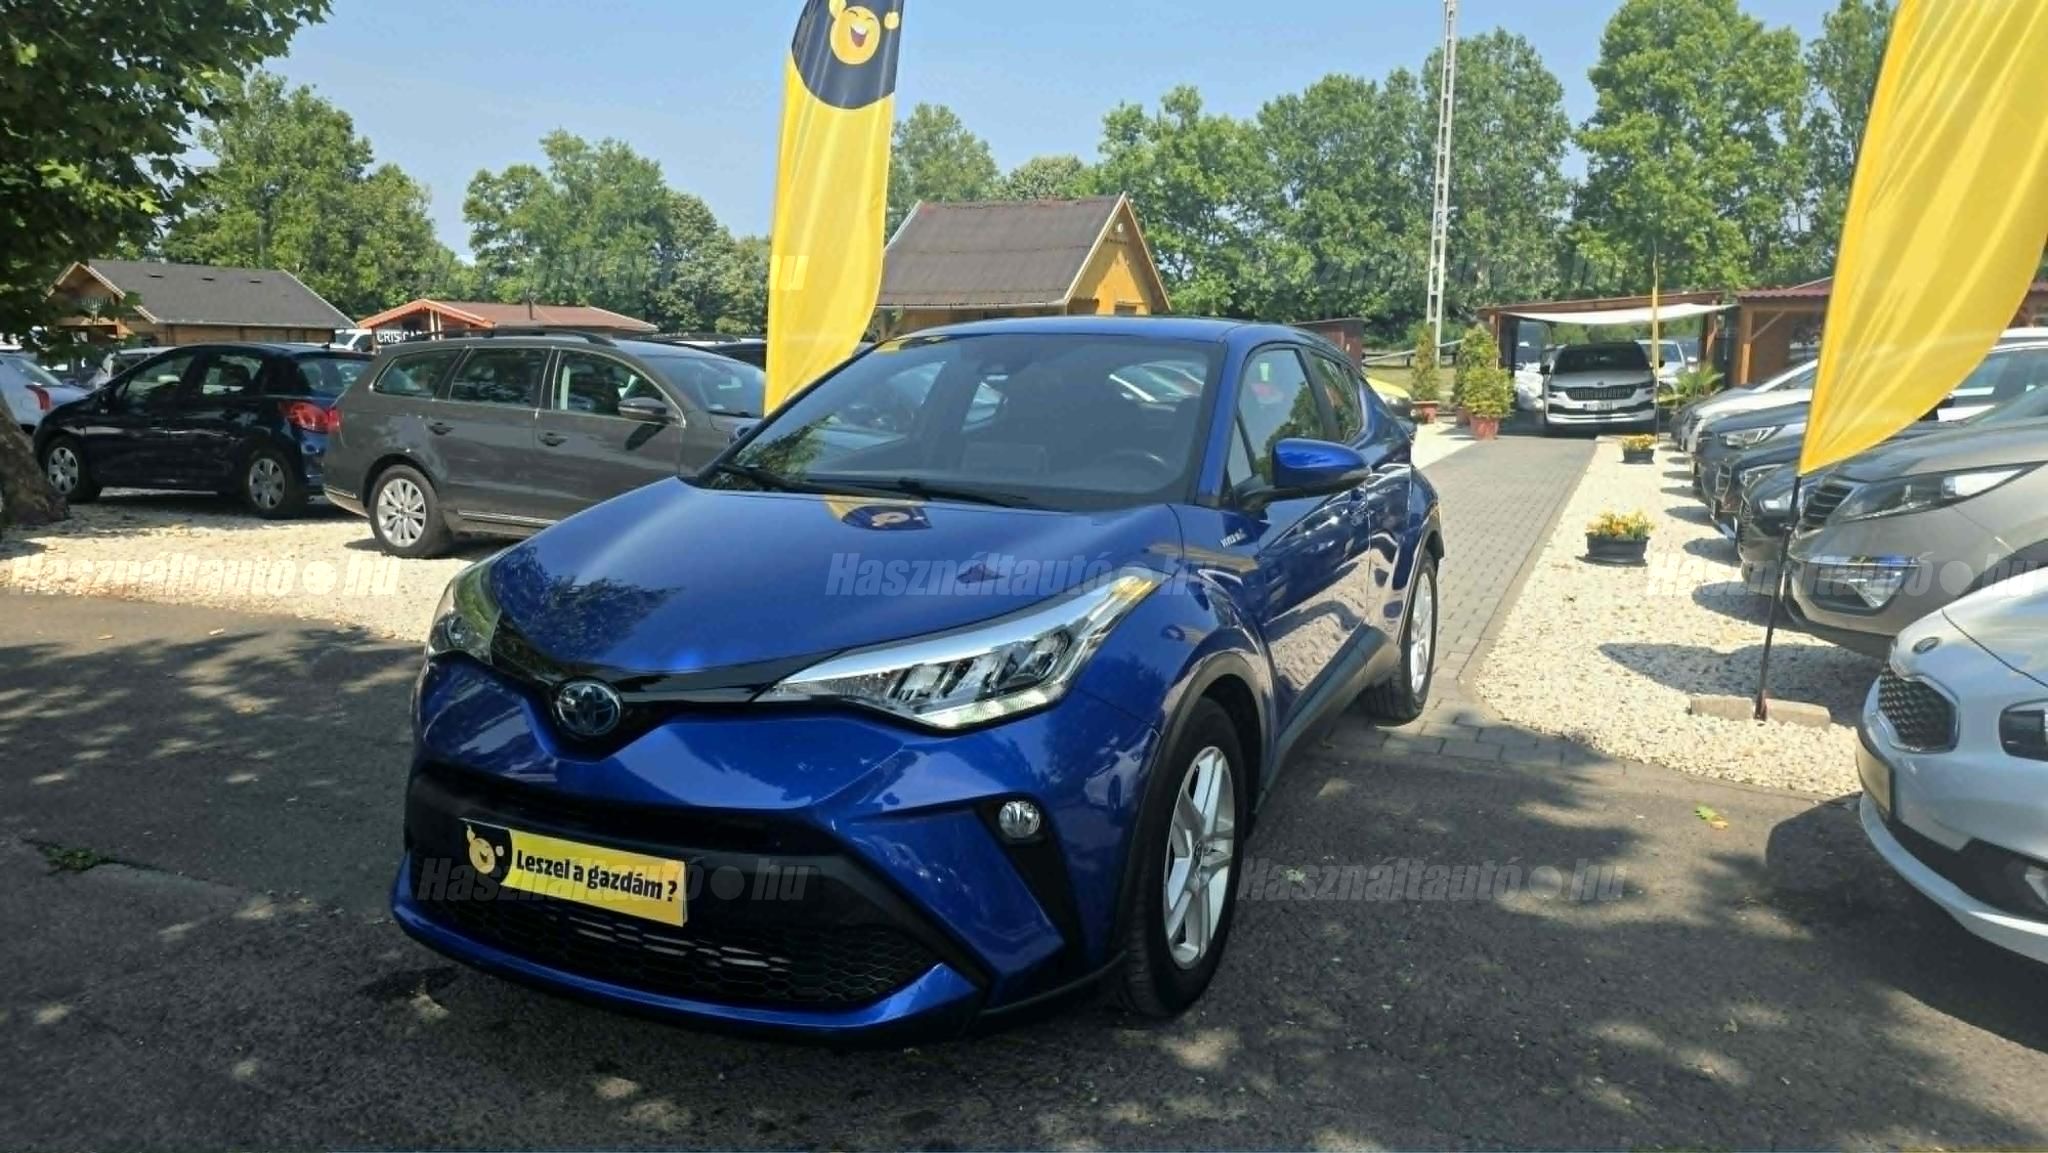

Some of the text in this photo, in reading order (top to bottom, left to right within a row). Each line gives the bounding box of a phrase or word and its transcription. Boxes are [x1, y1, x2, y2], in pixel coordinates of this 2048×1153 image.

[516, 849, 571, 880] Leszel
[573, 863, 584, 883] a
[586, 865, 663, 900] gazdám
